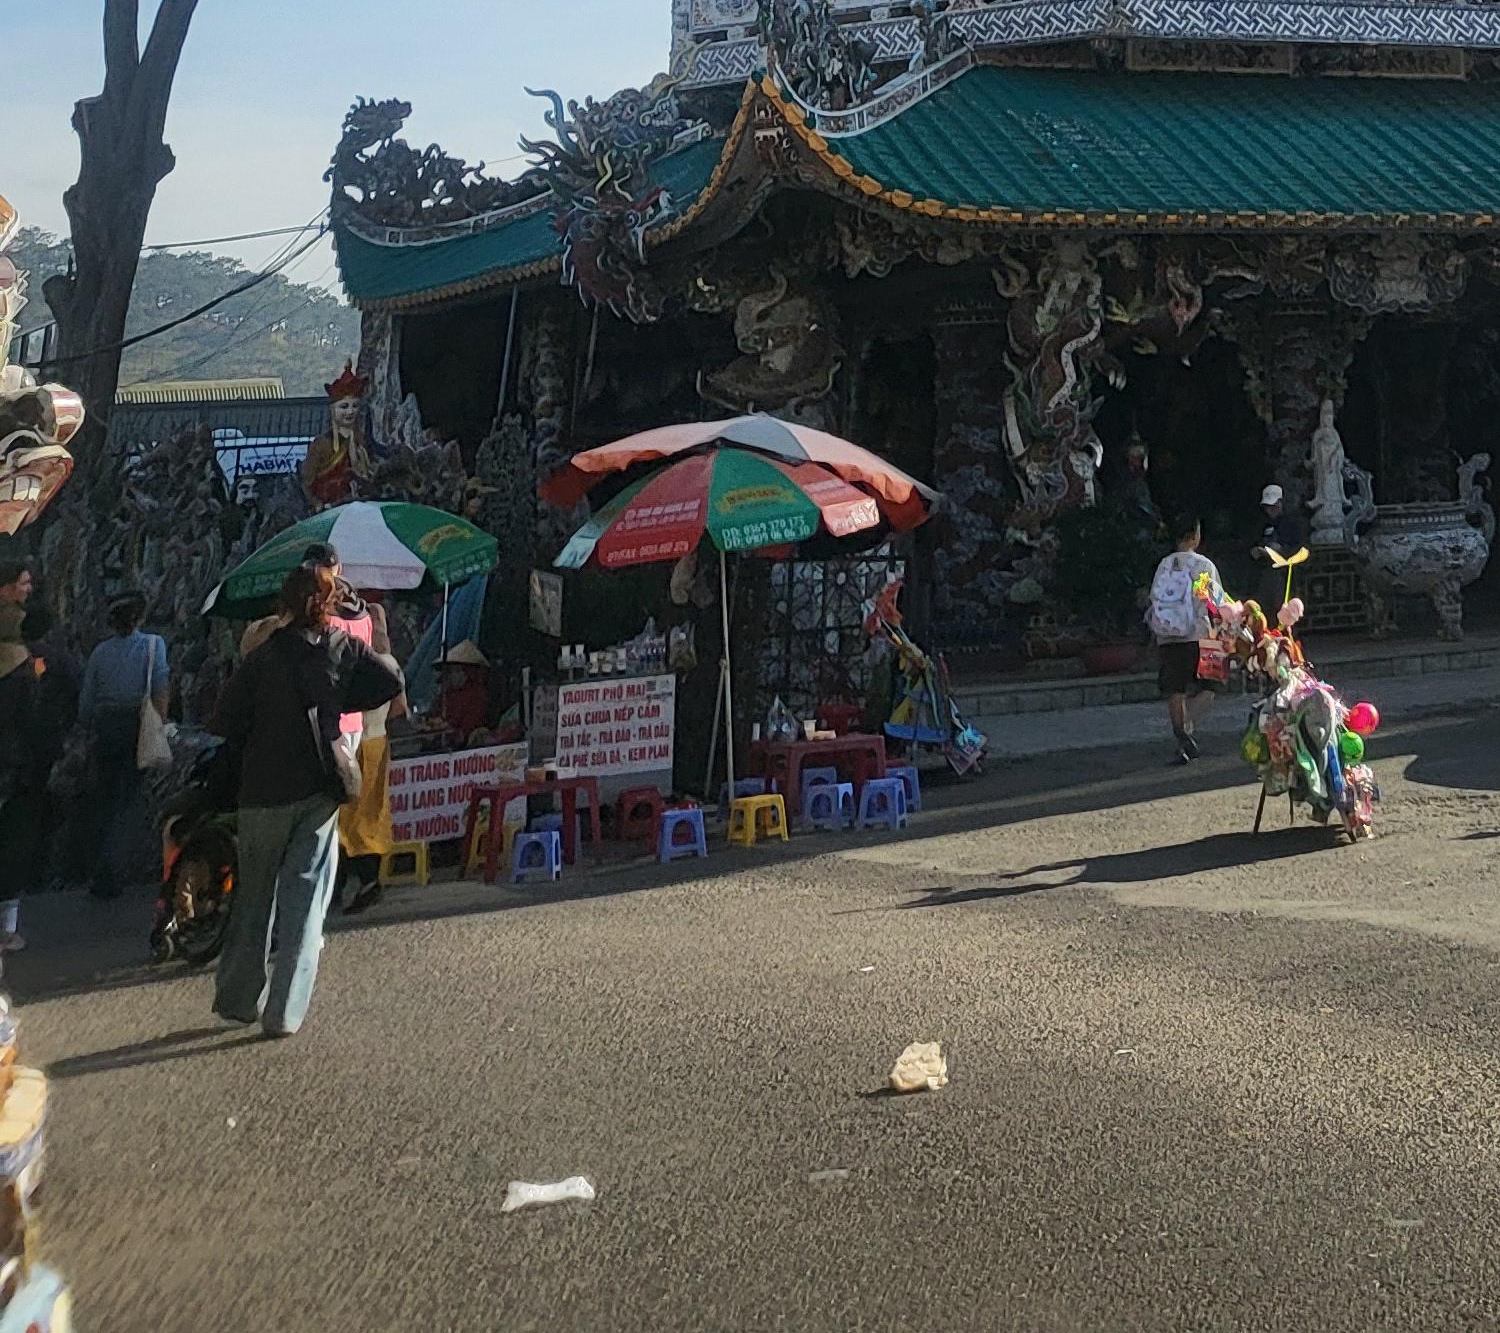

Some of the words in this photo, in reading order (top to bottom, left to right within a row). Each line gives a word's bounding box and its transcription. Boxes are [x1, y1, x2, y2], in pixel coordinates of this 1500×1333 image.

[626, 684, 645, 697] MAI
[585, 710, 611, 725] CHUA
[453, 752, 496, 777] NƯỚNG
[412, 788, 445, 810] LANG
